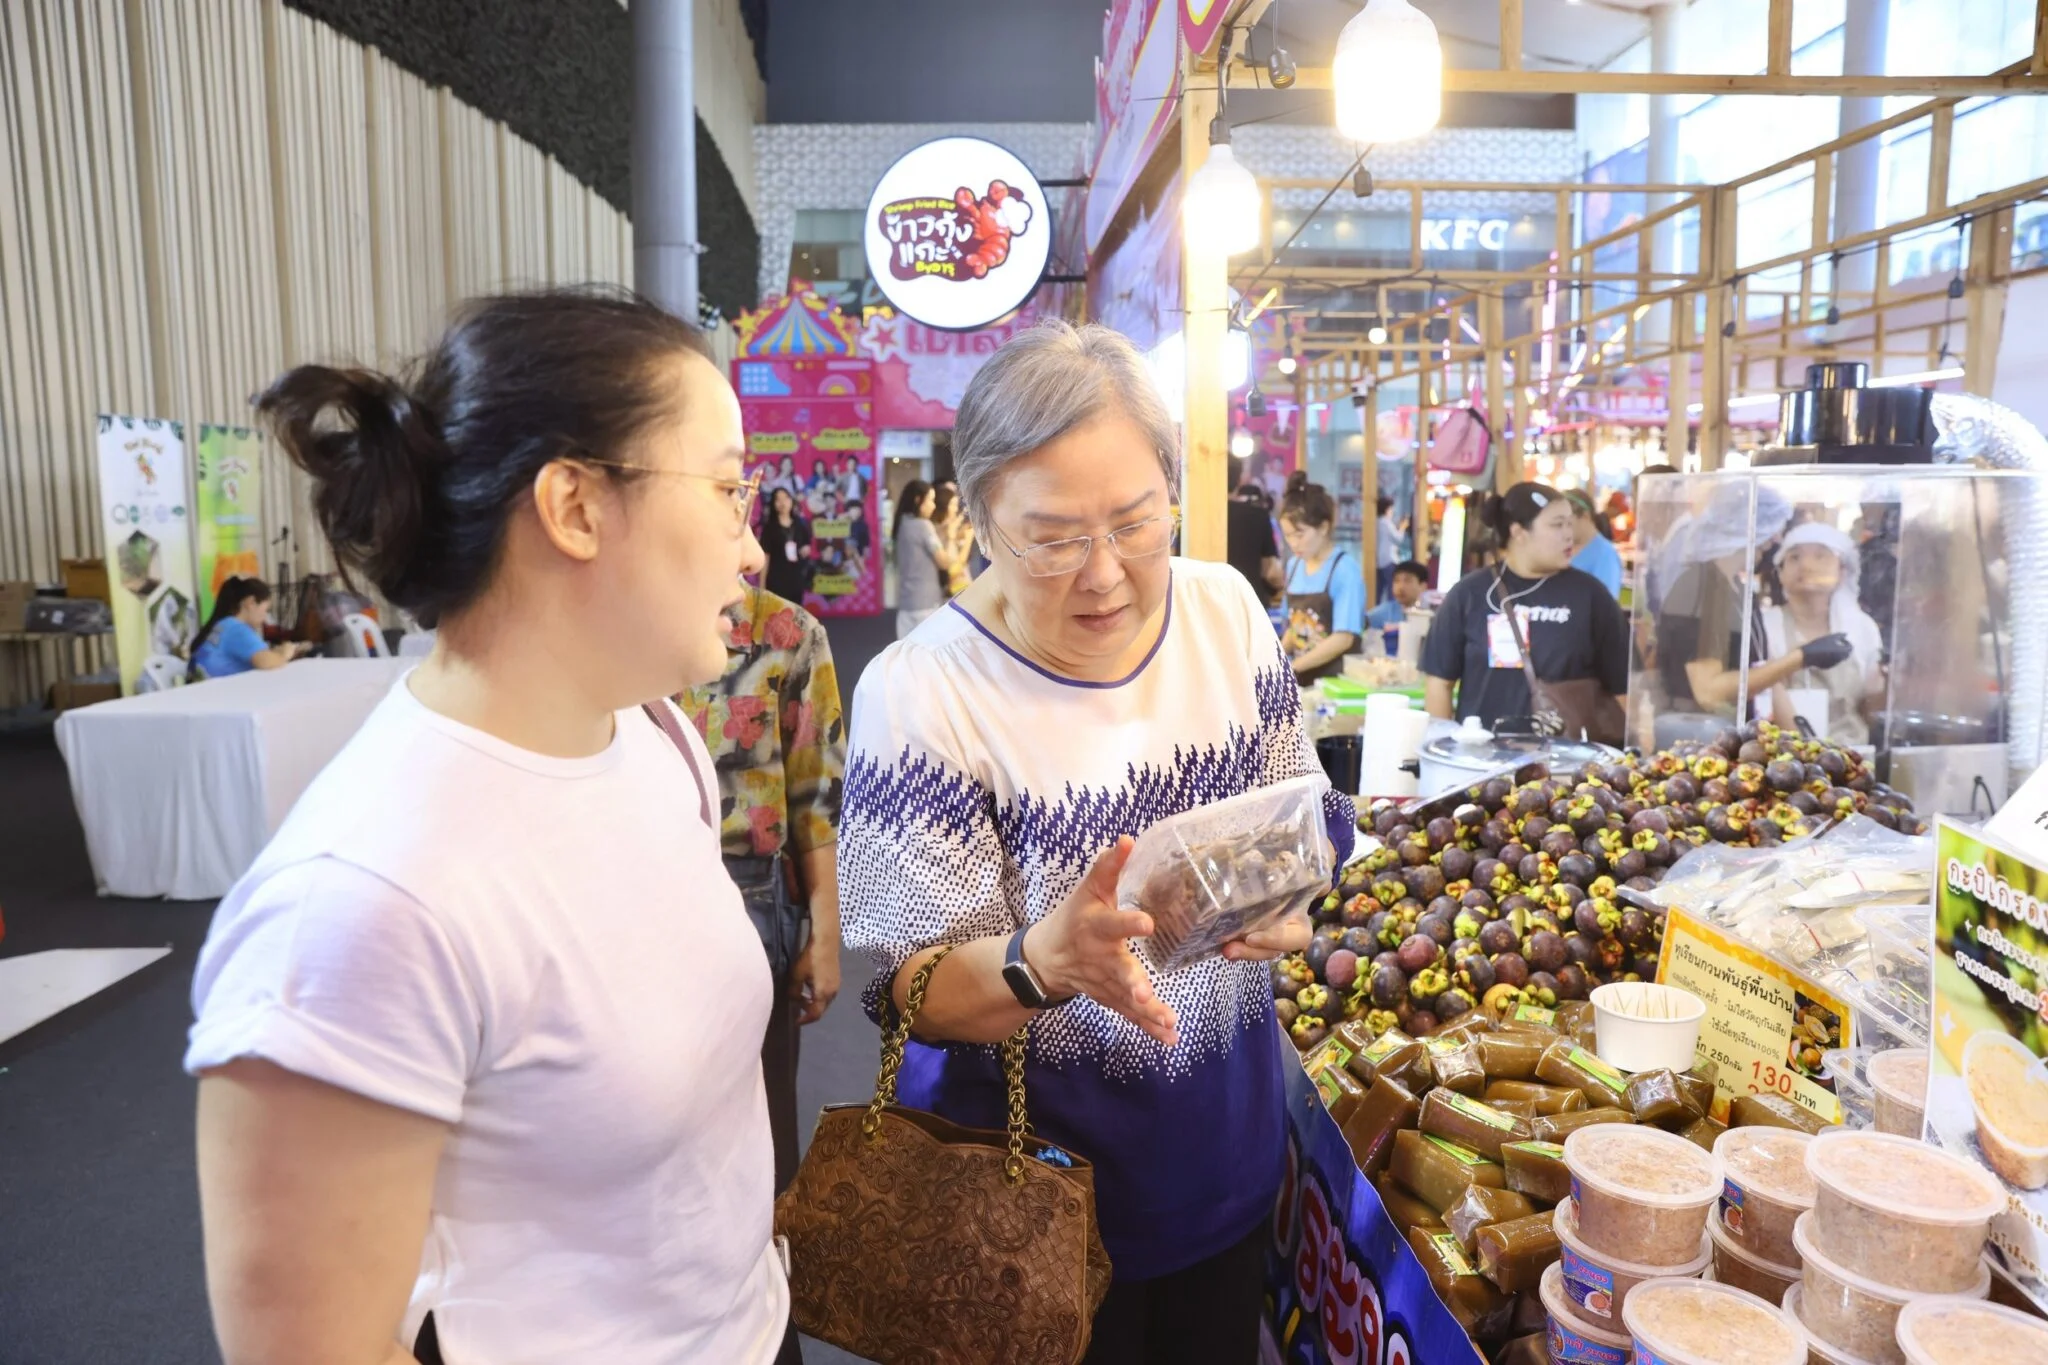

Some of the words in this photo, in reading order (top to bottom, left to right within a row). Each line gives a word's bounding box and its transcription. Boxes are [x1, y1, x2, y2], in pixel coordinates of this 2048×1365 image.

[885, 210, 973, 248] ข้าวกุ้ง
[1420, 219, 1510, 251] KFC
[1674, 943, 1793, 1014] ทุเรียนกวนพันธุ์พื้นบ้าน
[1752, 1060, 1792, 1095] 130
[1793, 1090, 1818, 1110] บาท
